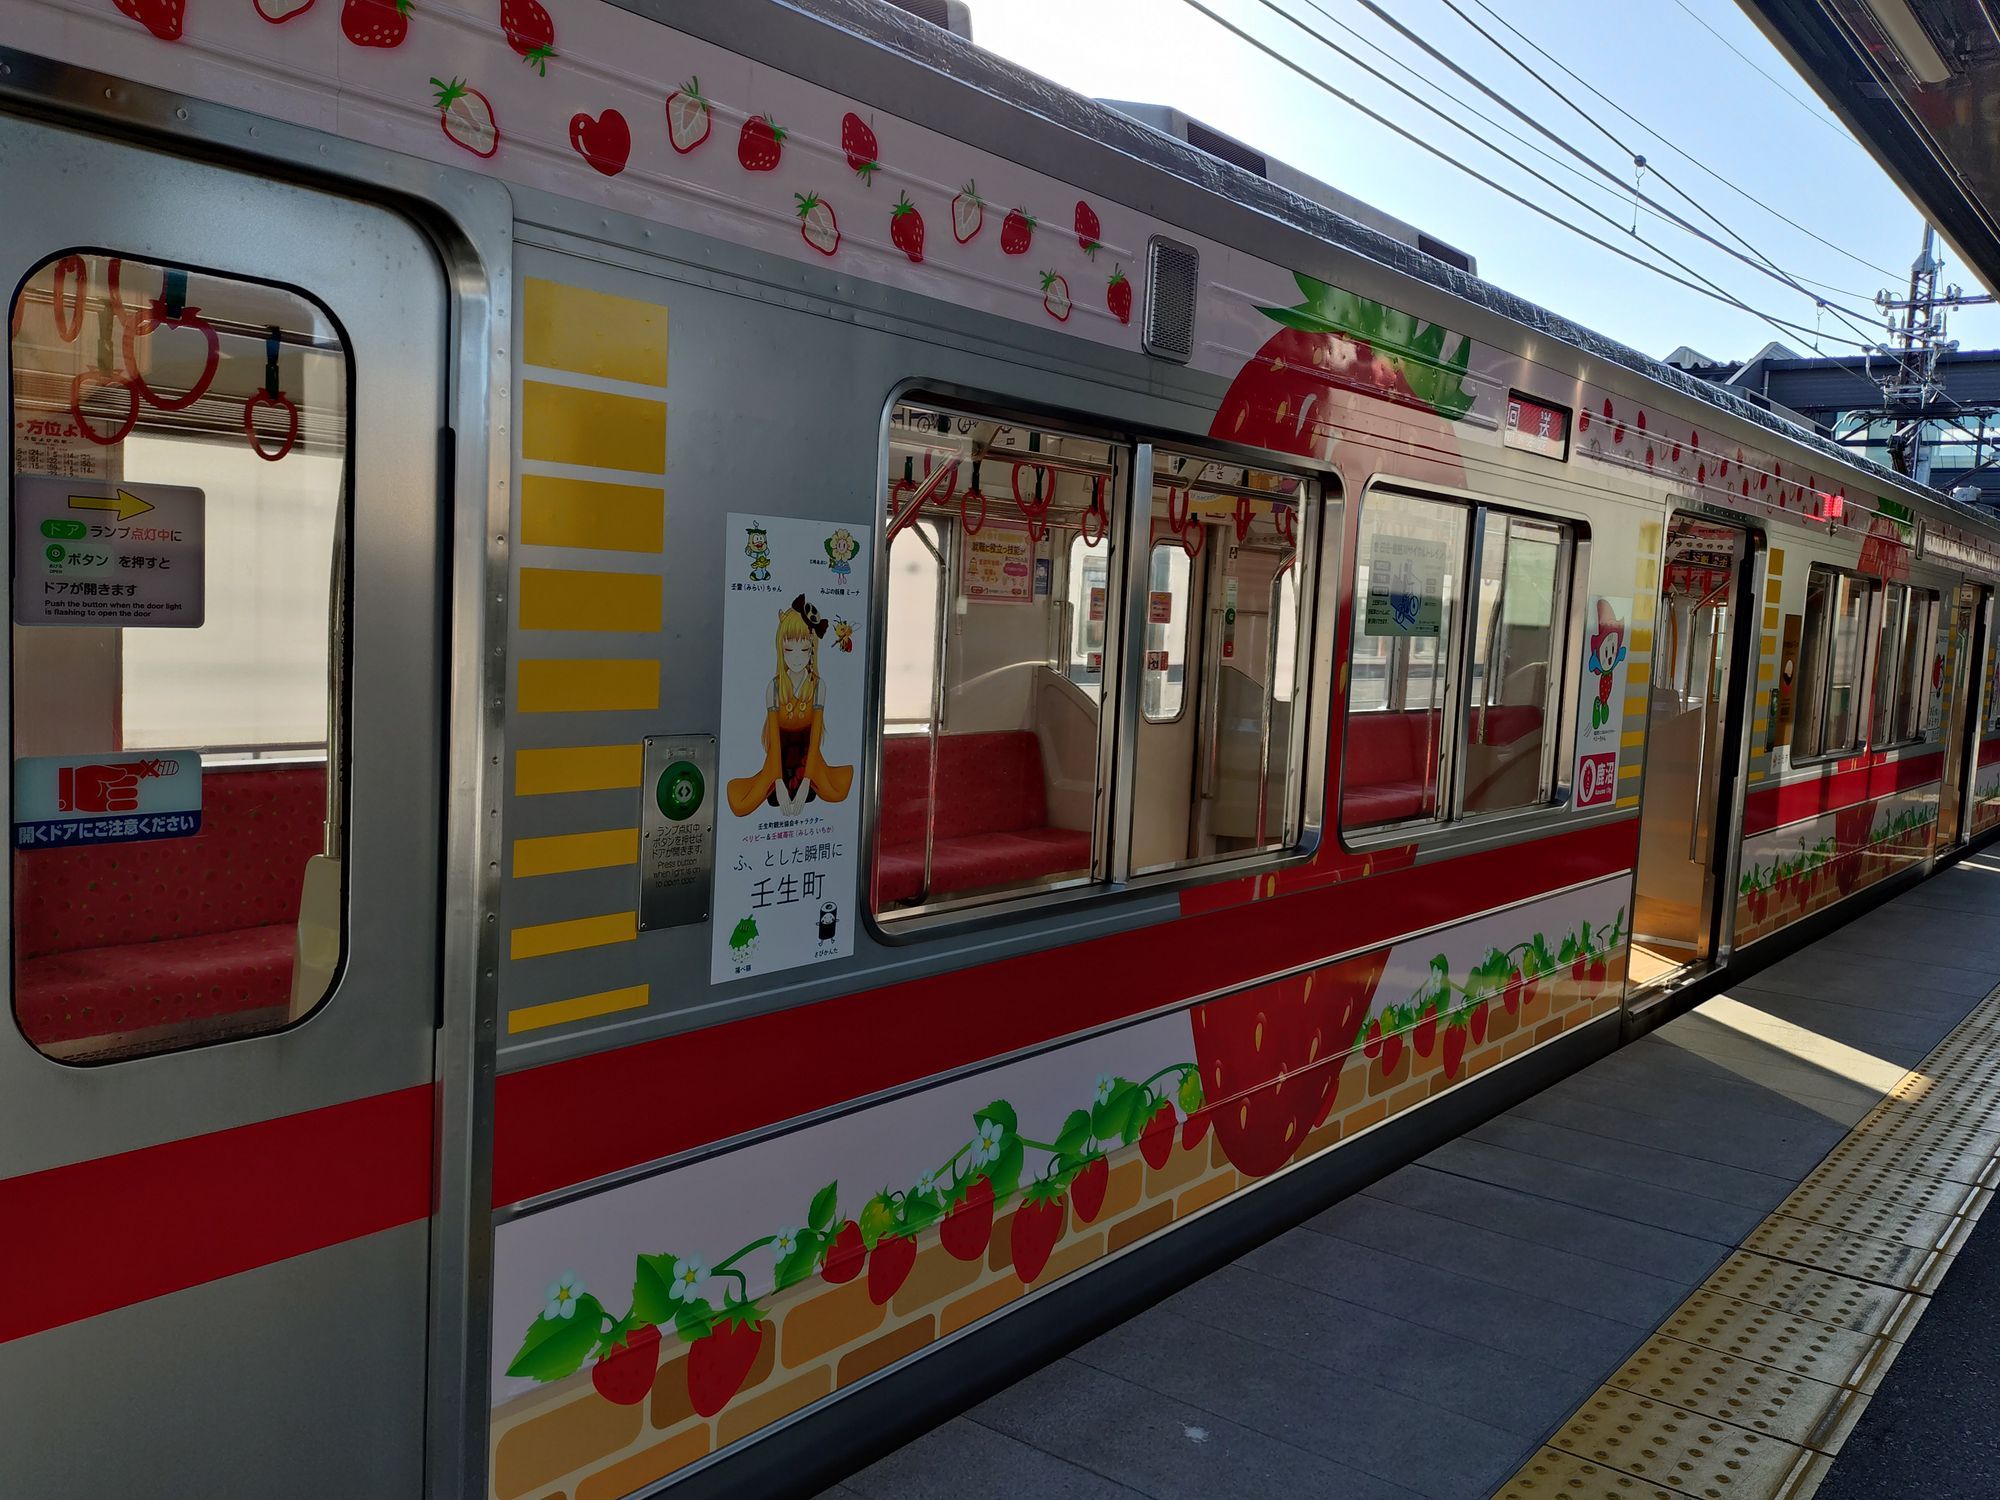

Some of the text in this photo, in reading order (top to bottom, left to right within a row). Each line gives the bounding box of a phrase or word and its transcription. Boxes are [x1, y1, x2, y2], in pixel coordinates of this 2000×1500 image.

[50, 522, 182, 542] ドア ランプ点灯中に
[68, 554, 170, 569] ボタン を押すと
[44, 582, 137, 596] ドアが開きます
[54, 608, 85, 617] flashing
[98, 610, 117, 618] open
[82, 600, 108, 608] button
[110, 601, 130, 609] when
[165, 603, 182, 611] light
[1596, 761, 1614, 786] 鹿沼
[18, 815, 194, 844] 開くドアにご注意ください
[658, 823, 700, 837] ランプ点灯中
[733, 843, 843, 871] ふ、とした瞬間に
[751, 871, 826, 909] 壬生町
